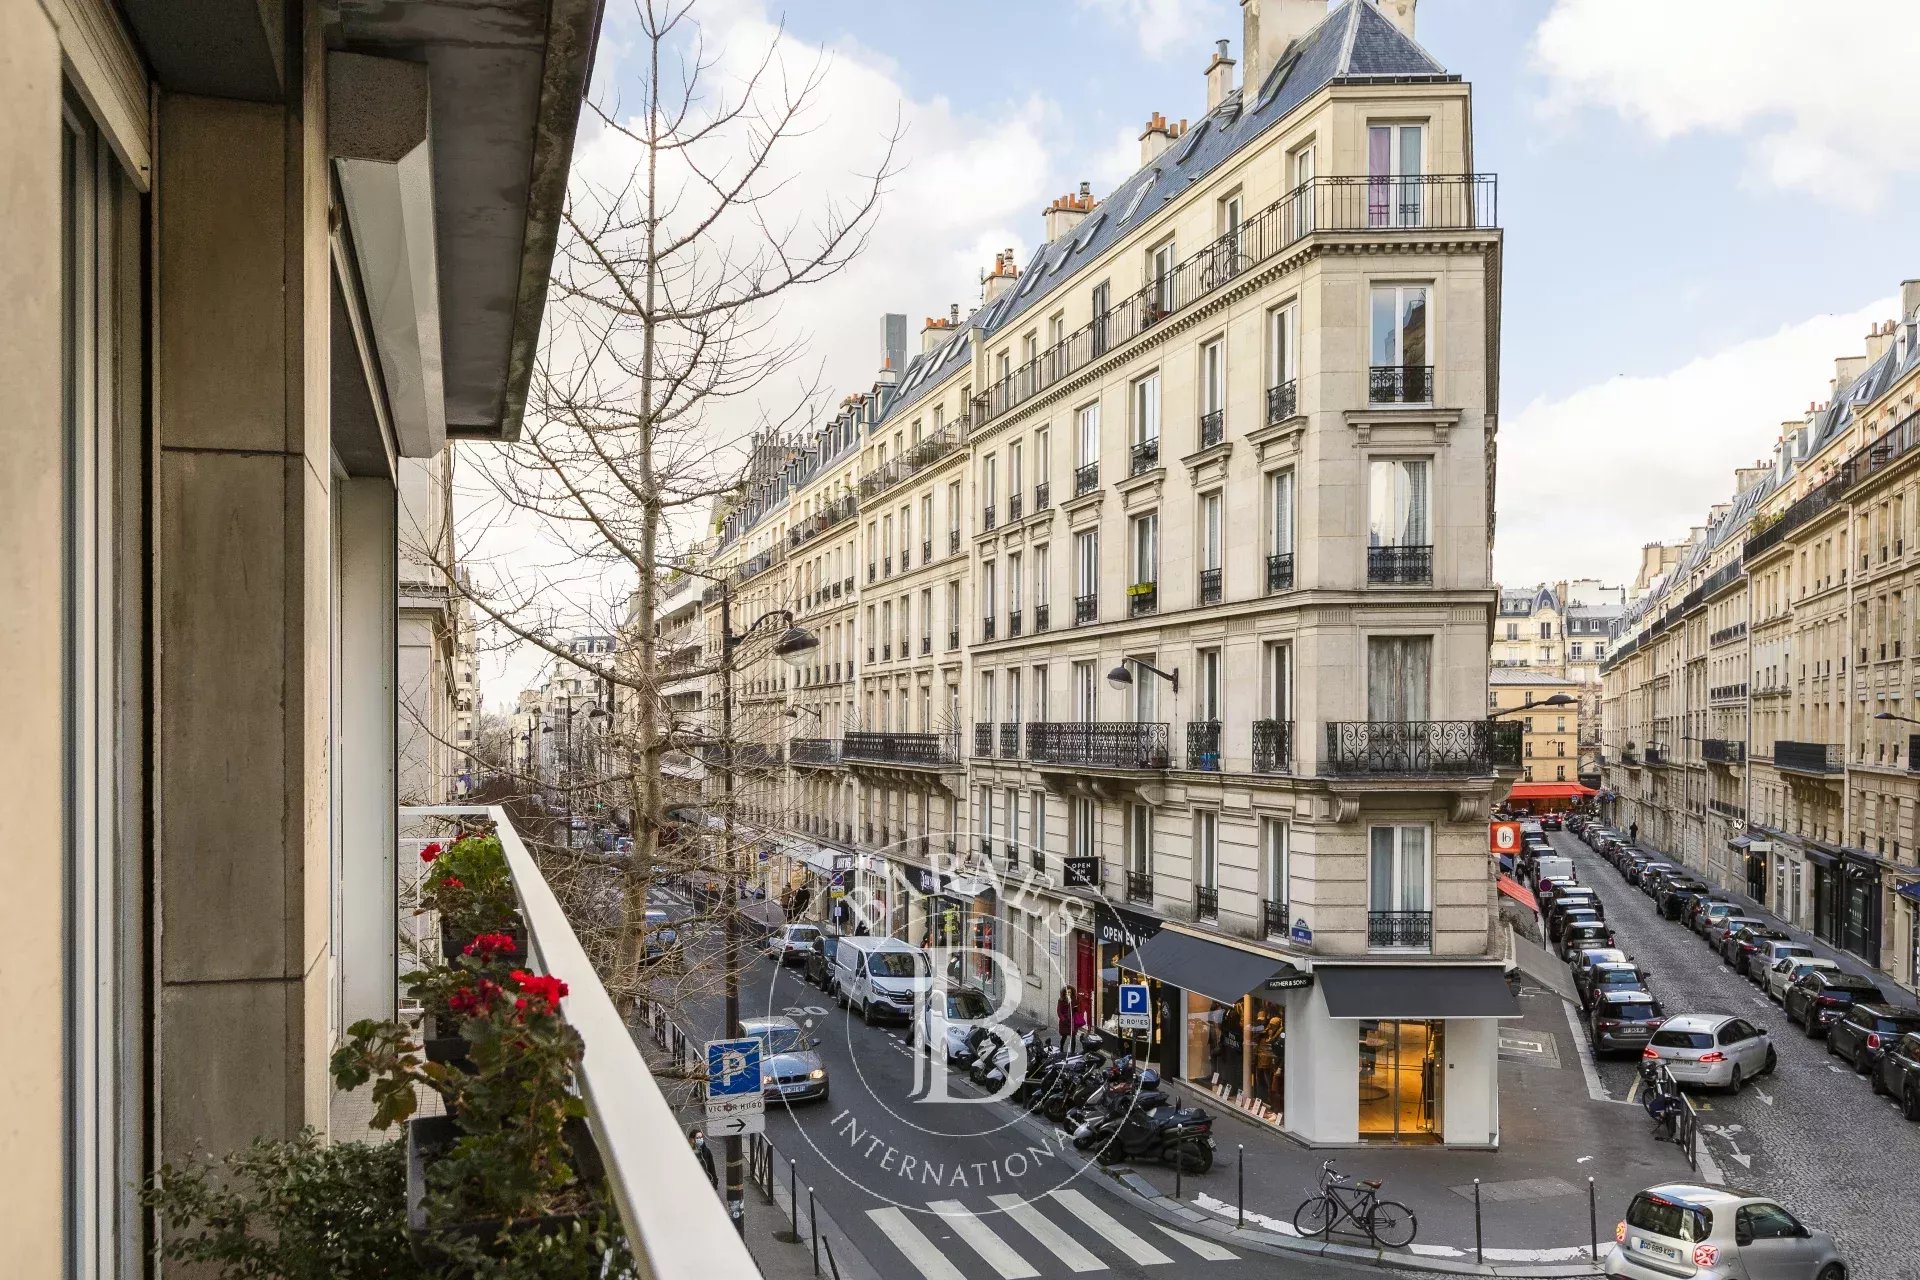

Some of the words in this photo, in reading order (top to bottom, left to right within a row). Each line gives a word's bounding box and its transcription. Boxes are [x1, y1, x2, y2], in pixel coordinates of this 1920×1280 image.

[1103, 925, 1123, 943] OPEN
[1126, 932, 1137, 948] EN
[1292, 979, 1307, 987] SONS
[1127, 991, 1140, 1009] P
[782, 1006, 829, 1016] 30
[722, 1050, 746, 1087] P
[708, 1104, 738, 1113] VICTR
